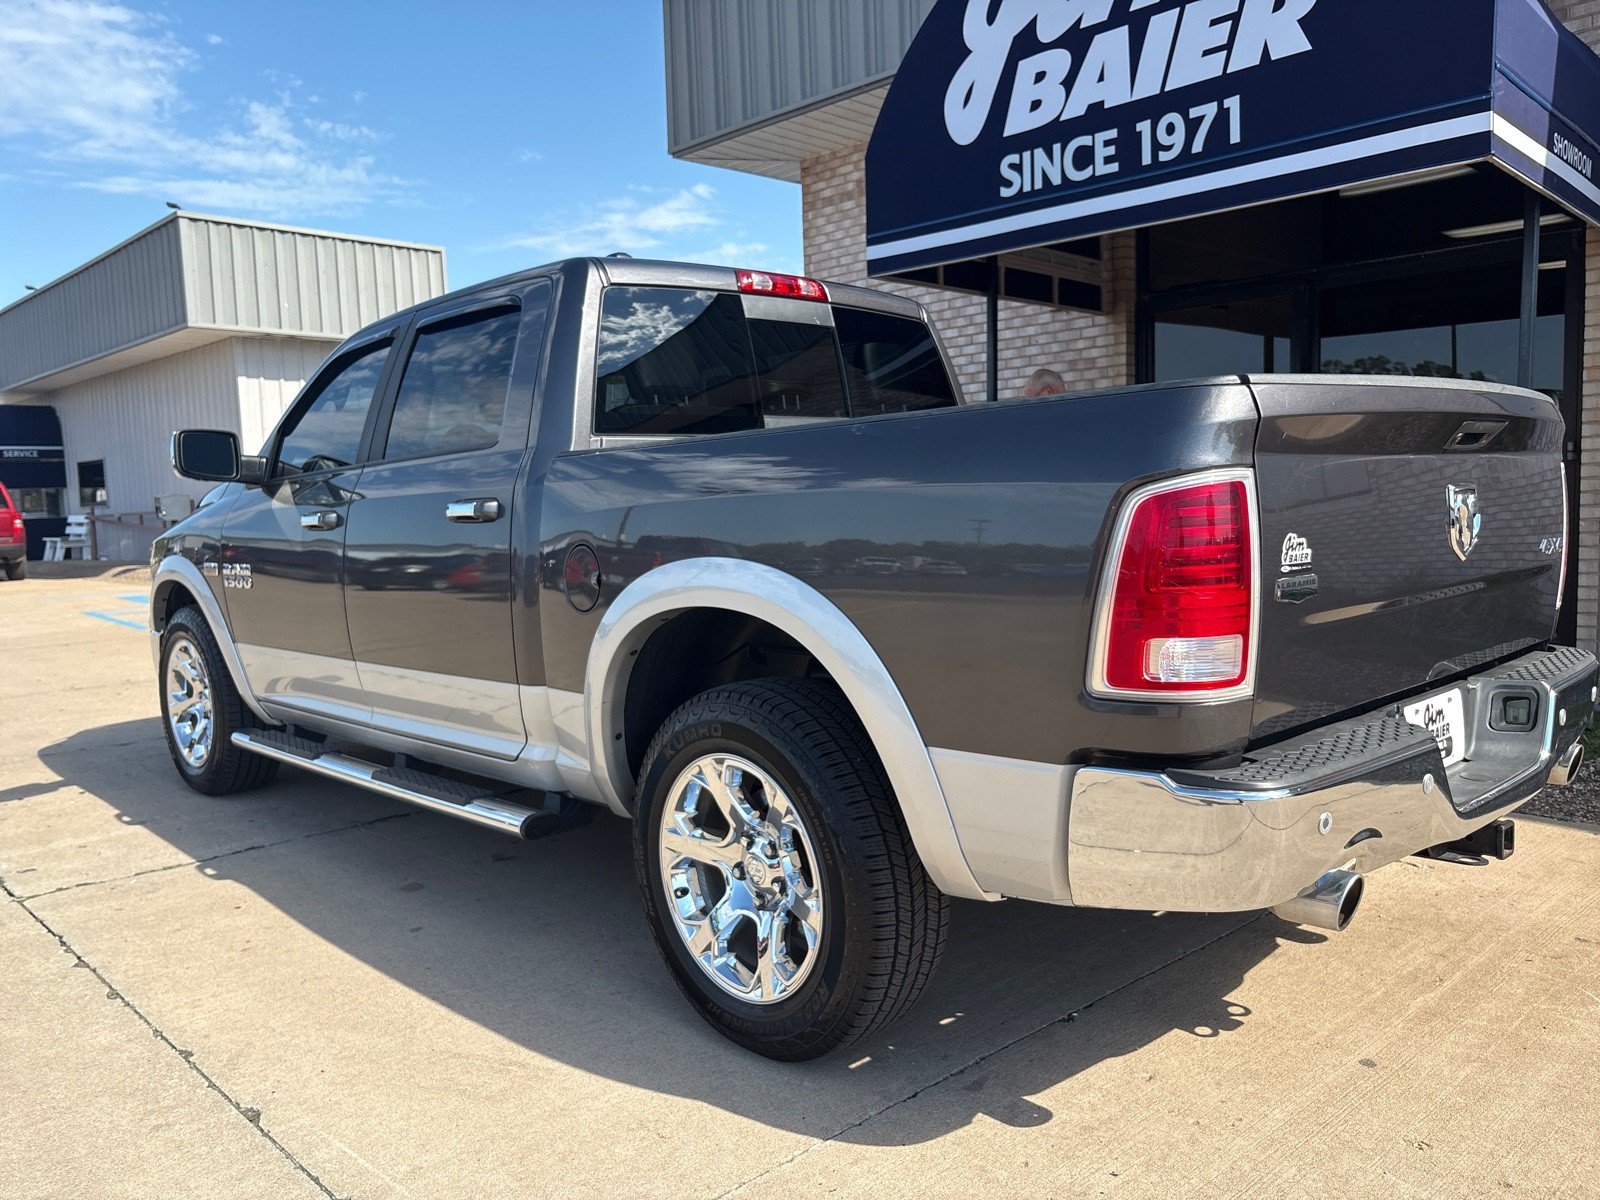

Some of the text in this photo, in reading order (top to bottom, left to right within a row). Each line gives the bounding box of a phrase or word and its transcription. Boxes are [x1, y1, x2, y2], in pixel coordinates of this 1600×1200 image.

[1003, 0, 1317, 137] BAIER
[1000, 94, 1241, 198] SINCE 1971
[1553, 132, 1593, 179] SHOWROOM
[2, 449, 39, 458] SERVICE
[1283, 534, 1305, 562] Jim
[1288, 552, 1309, 563] BAIER
[222, 562, 251, 576] RAM
[224, 575, 252, 589] 1500
[1281, 578, 1317, 590] LARAMIE
